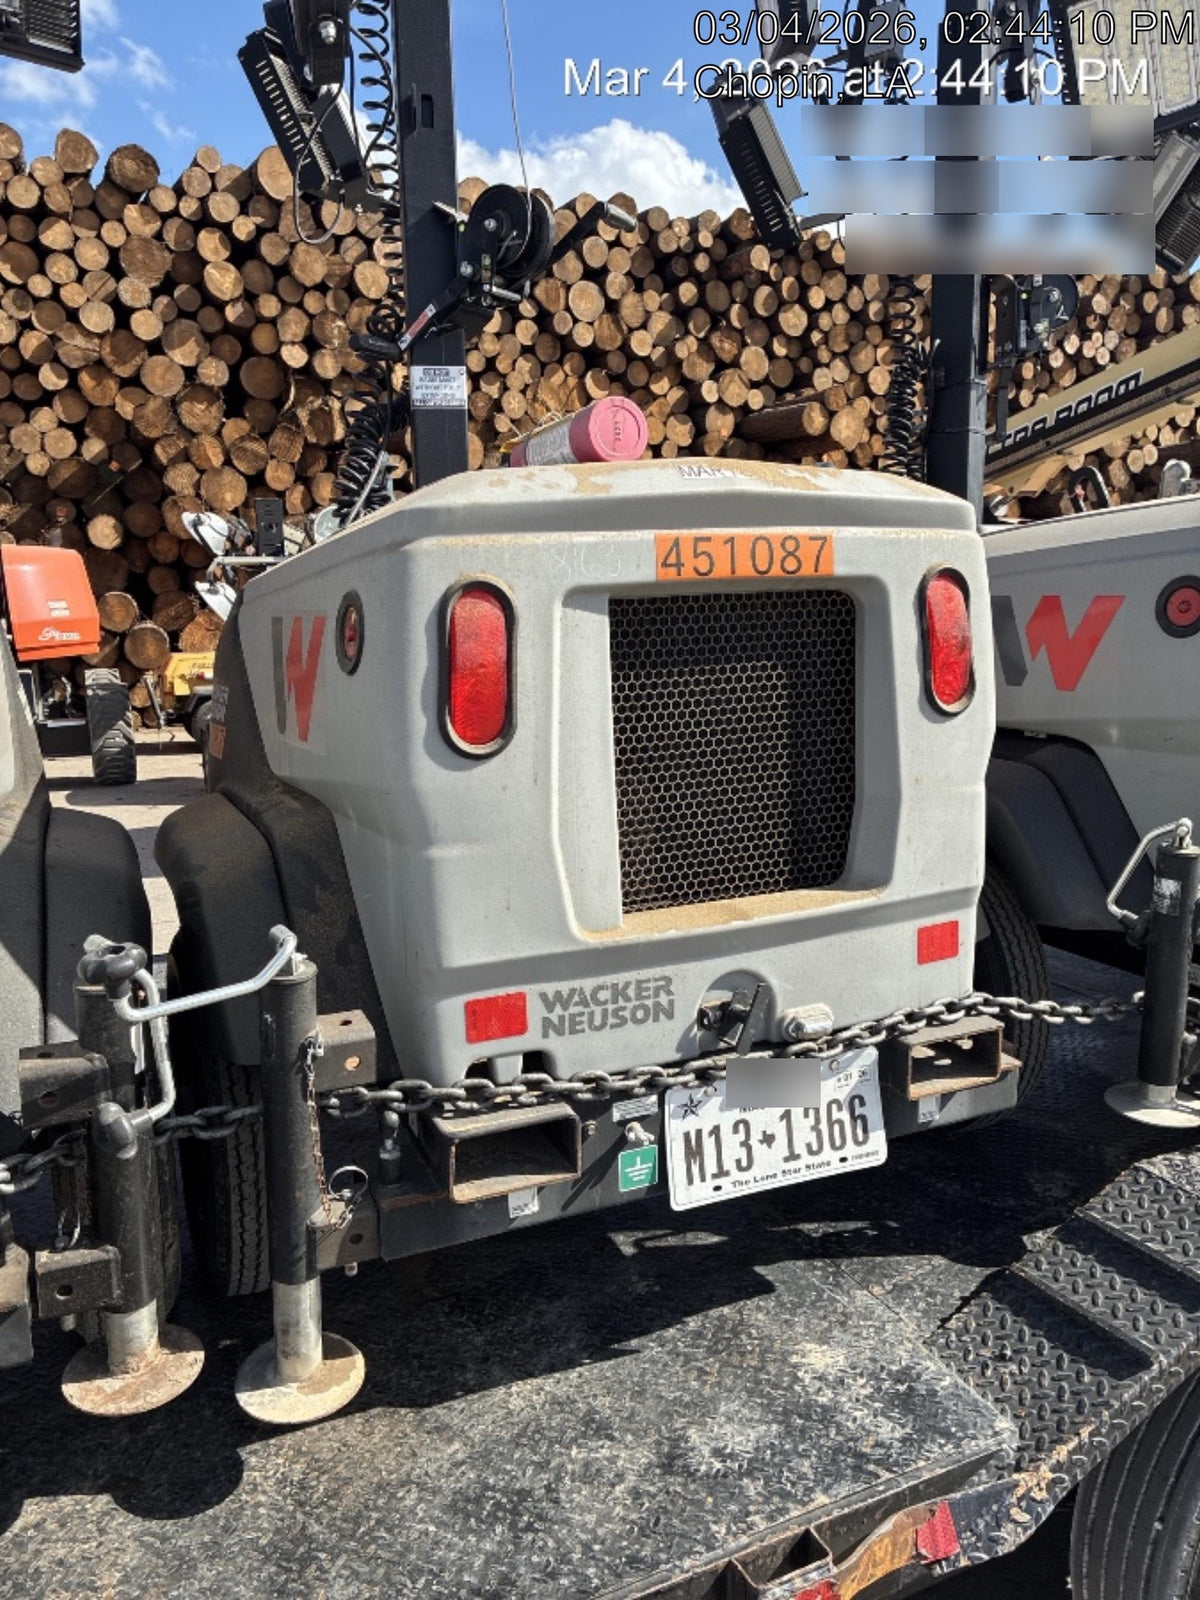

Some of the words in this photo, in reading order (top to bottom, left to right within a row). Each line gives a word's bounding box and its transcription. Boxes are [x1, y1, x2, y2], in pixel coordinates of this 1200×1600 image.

[660, 534, 828, 577] 451087
[538, 976, 675, 1013] WACKER
[542, 999, 675, 1039] NEUSON
